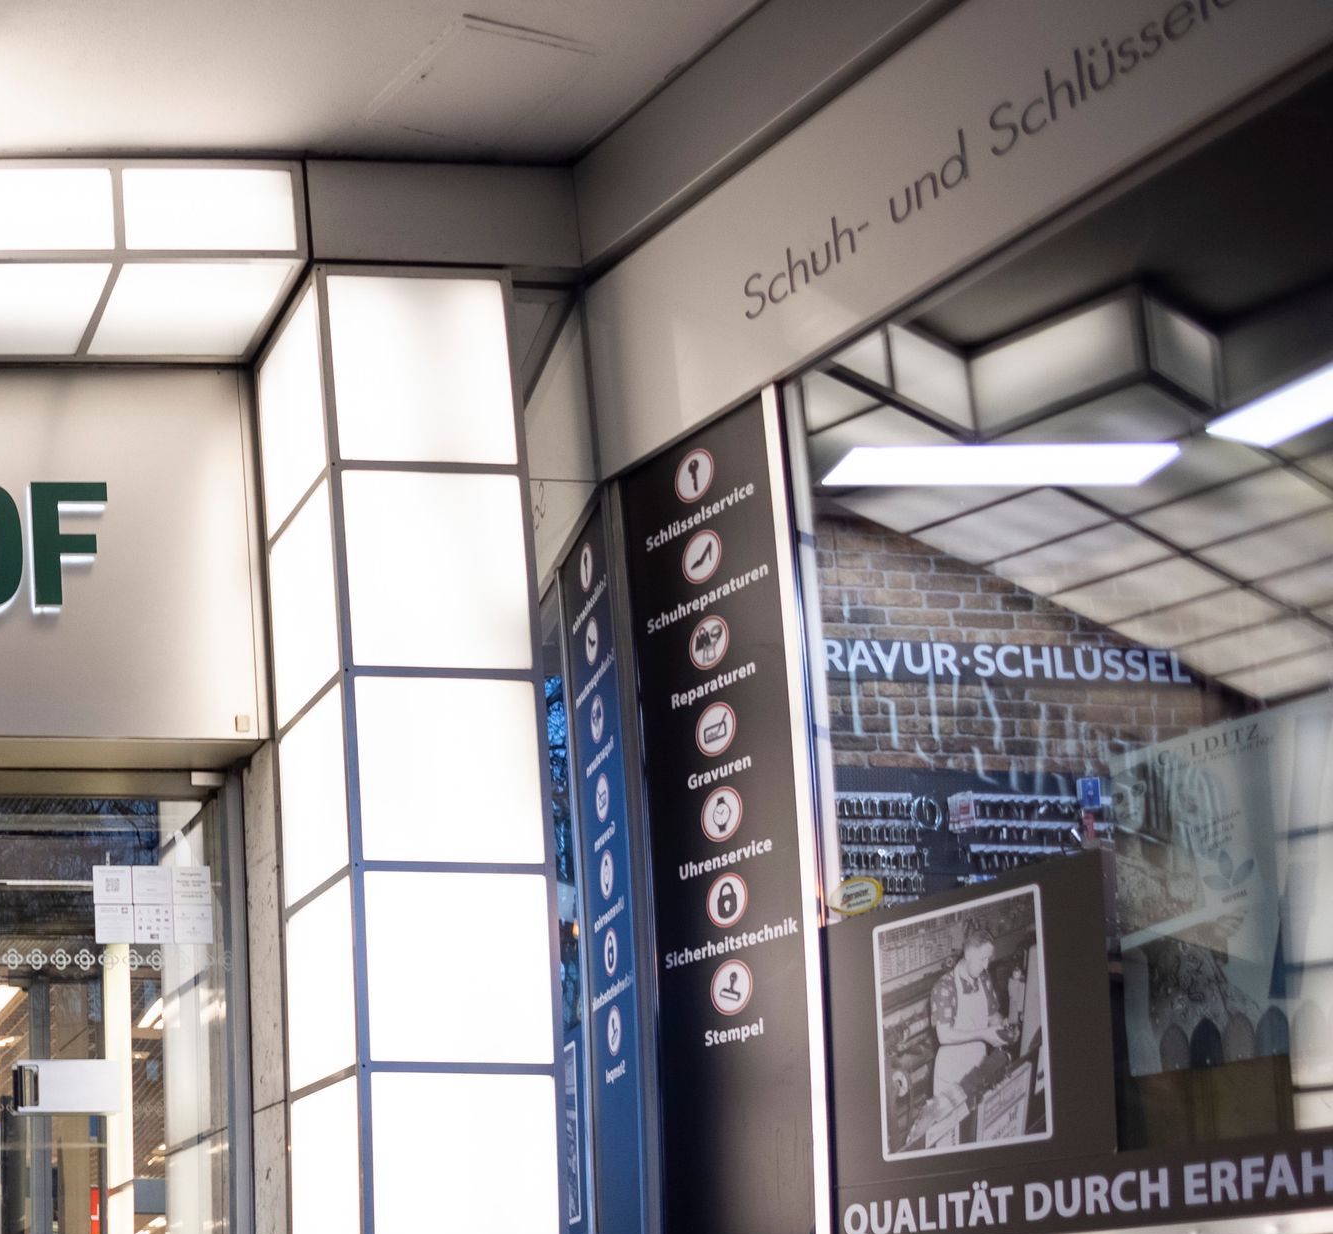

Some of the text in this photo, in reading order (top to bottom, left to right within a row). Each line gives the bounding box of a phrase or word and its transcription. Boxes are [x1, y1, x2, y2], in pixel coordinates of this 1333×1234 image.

[742, 215, 870, 319] Schuh-
[888, 128, 968, 224] und
[645, 482, 754, 552] Schlüsselservice
[647, 562, 768, 634] Schuhreparaturen
[671, 661, 755, 709] Reparaturen
[687, 755, 752, 789] Gravuren
[678, 838, 772, 881] Uhrenservice
[664, 918, 798, 970] Sicherheitstechnik
[704, 1018, 764, 1047] Stempel
[1025, 1167, 1169, 1222] DURCH
[1184, 1149, 1333, 1206] ERFAH
